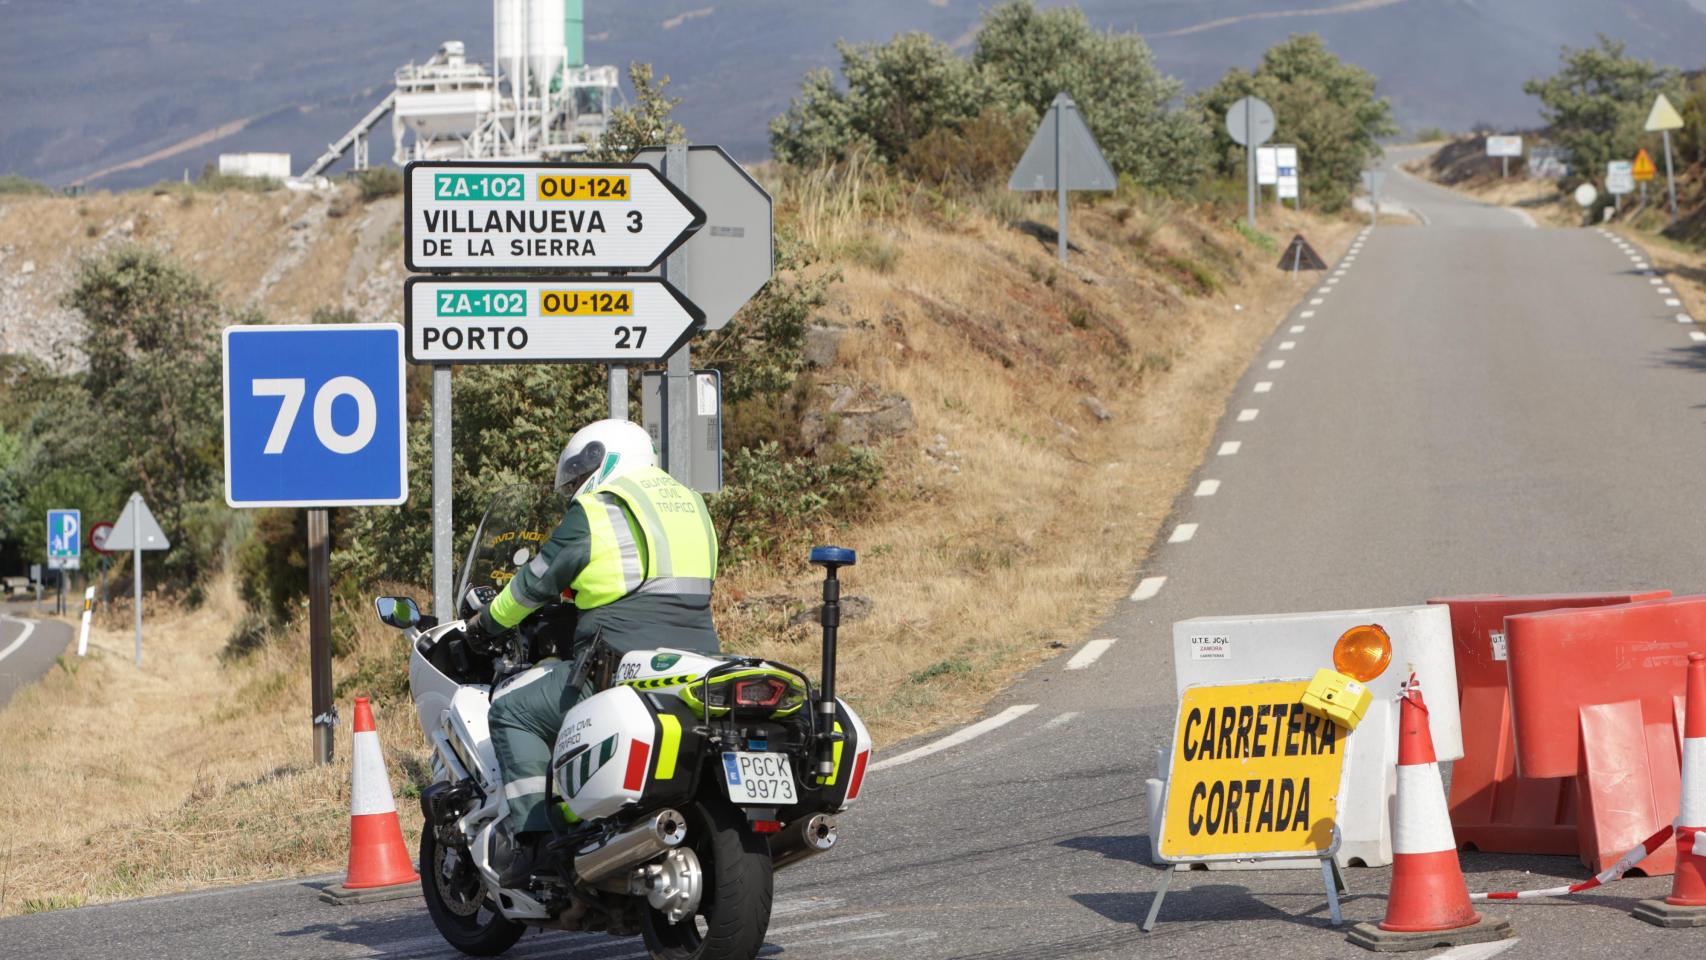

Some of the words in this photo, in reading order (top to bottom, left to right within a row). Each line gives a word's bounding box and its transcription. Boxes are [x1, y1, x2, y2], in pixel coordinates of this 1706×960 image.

[438, 177, 521, 197] ZA-102
[540, 178, 627, 197] OU-124
[423, 210, 606, 233] VILLANUEVA
[626, 210, 643, 233] 3
[423, 239, 453, 257] DE
[467, 239, 495, 257] LA
[510, 239, 596, 257] SIERRA
[439, 293, 523, 313] ZA-102
[543, 293, 629, 312] OU-124
[423, 327, 528, 350] PORTO
[614, 326, 648, 349] 27
[252, 375, 377, 454] 70
[1184, 702, 1336, 761] CARRETERA
[740, 757, 788, 776] PGCK
[745, 779, 792, 799] 9973
[1188, 777, 1310, 836] CORTADA
